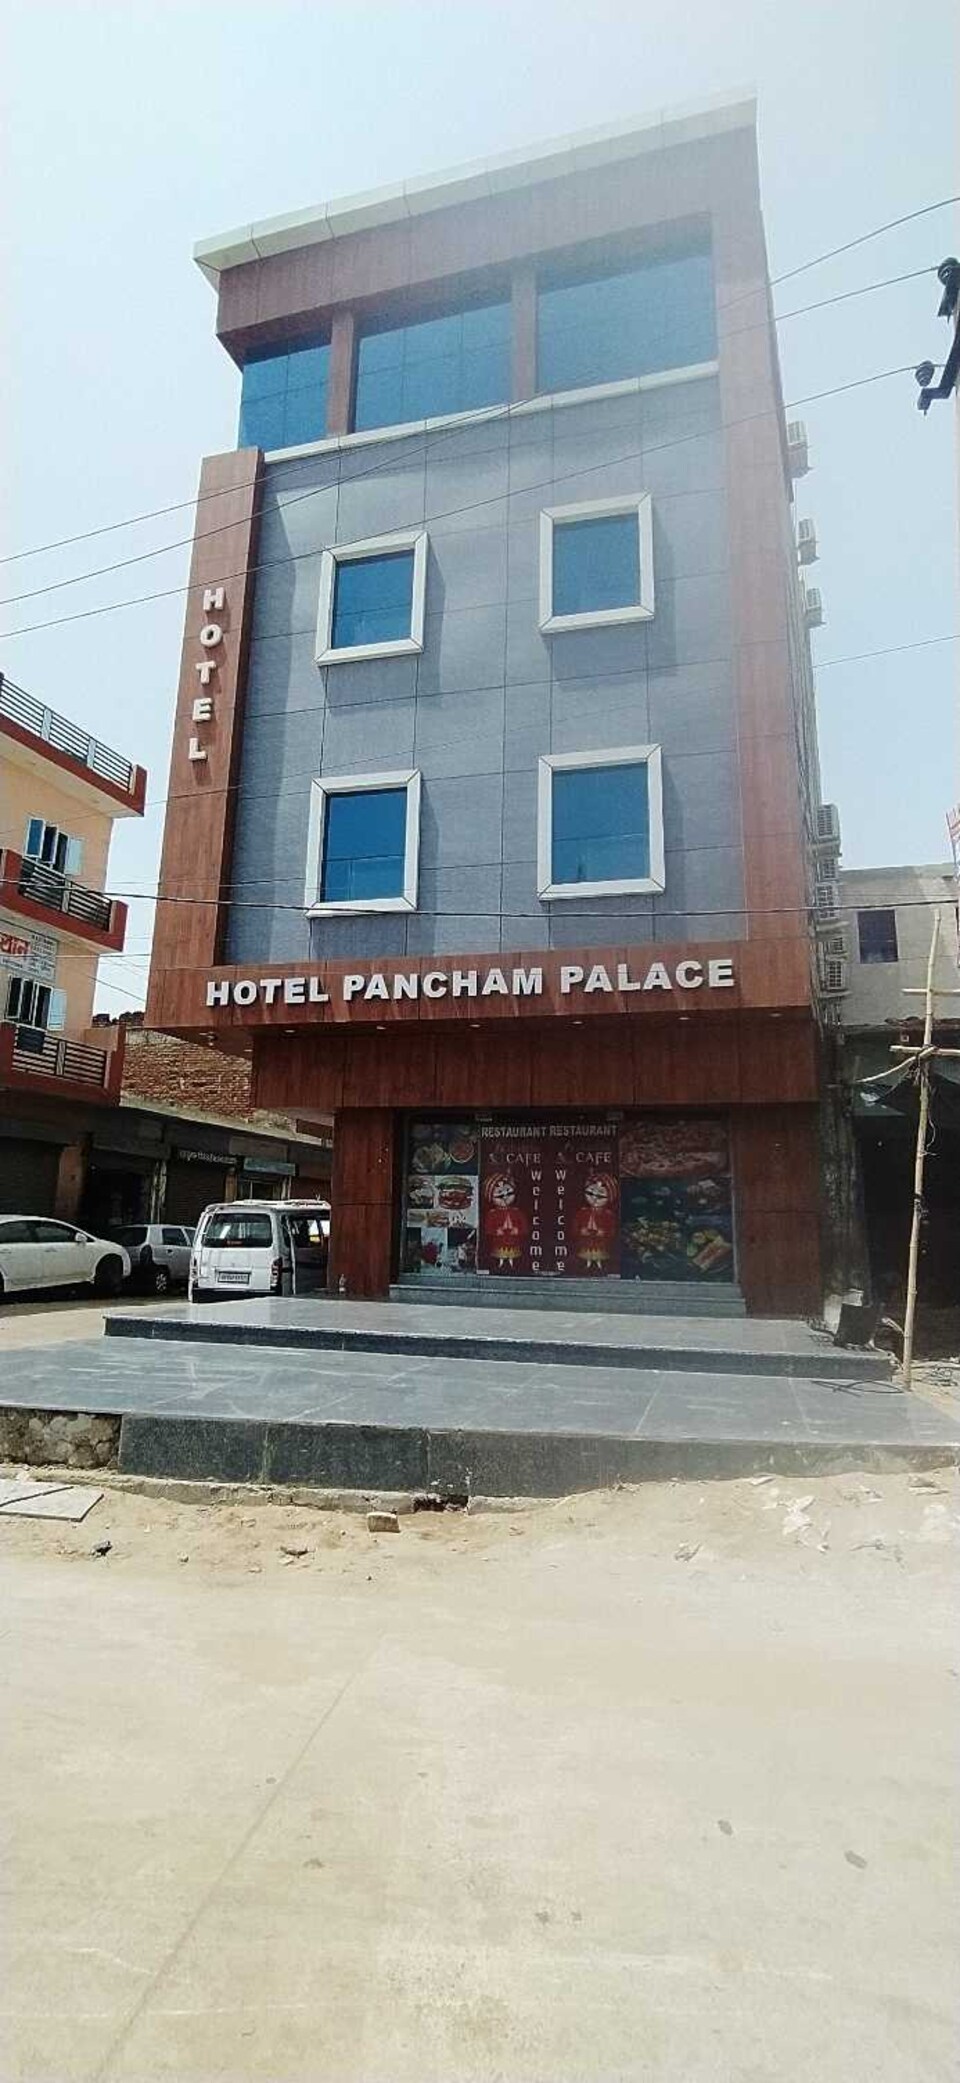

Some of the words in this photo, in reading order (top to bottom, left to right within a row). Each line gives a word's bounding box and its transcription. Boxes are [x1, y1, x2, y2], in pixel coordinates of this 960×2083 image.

[188, 587, 225, 761] HOTEL
[206, 978, 329, 1006] HOTEL
[343, 966, 543, 1001] PANCHAM
[561, 958, 735, 994] PALACE
[481, 1126, 547, 1138] RESTAURANT
[549, 1125, 618, 1137] RESTAURANT
[506, 1153, 542, 1167] CAFE
[575, 1152, 612, 1166] CAFE
